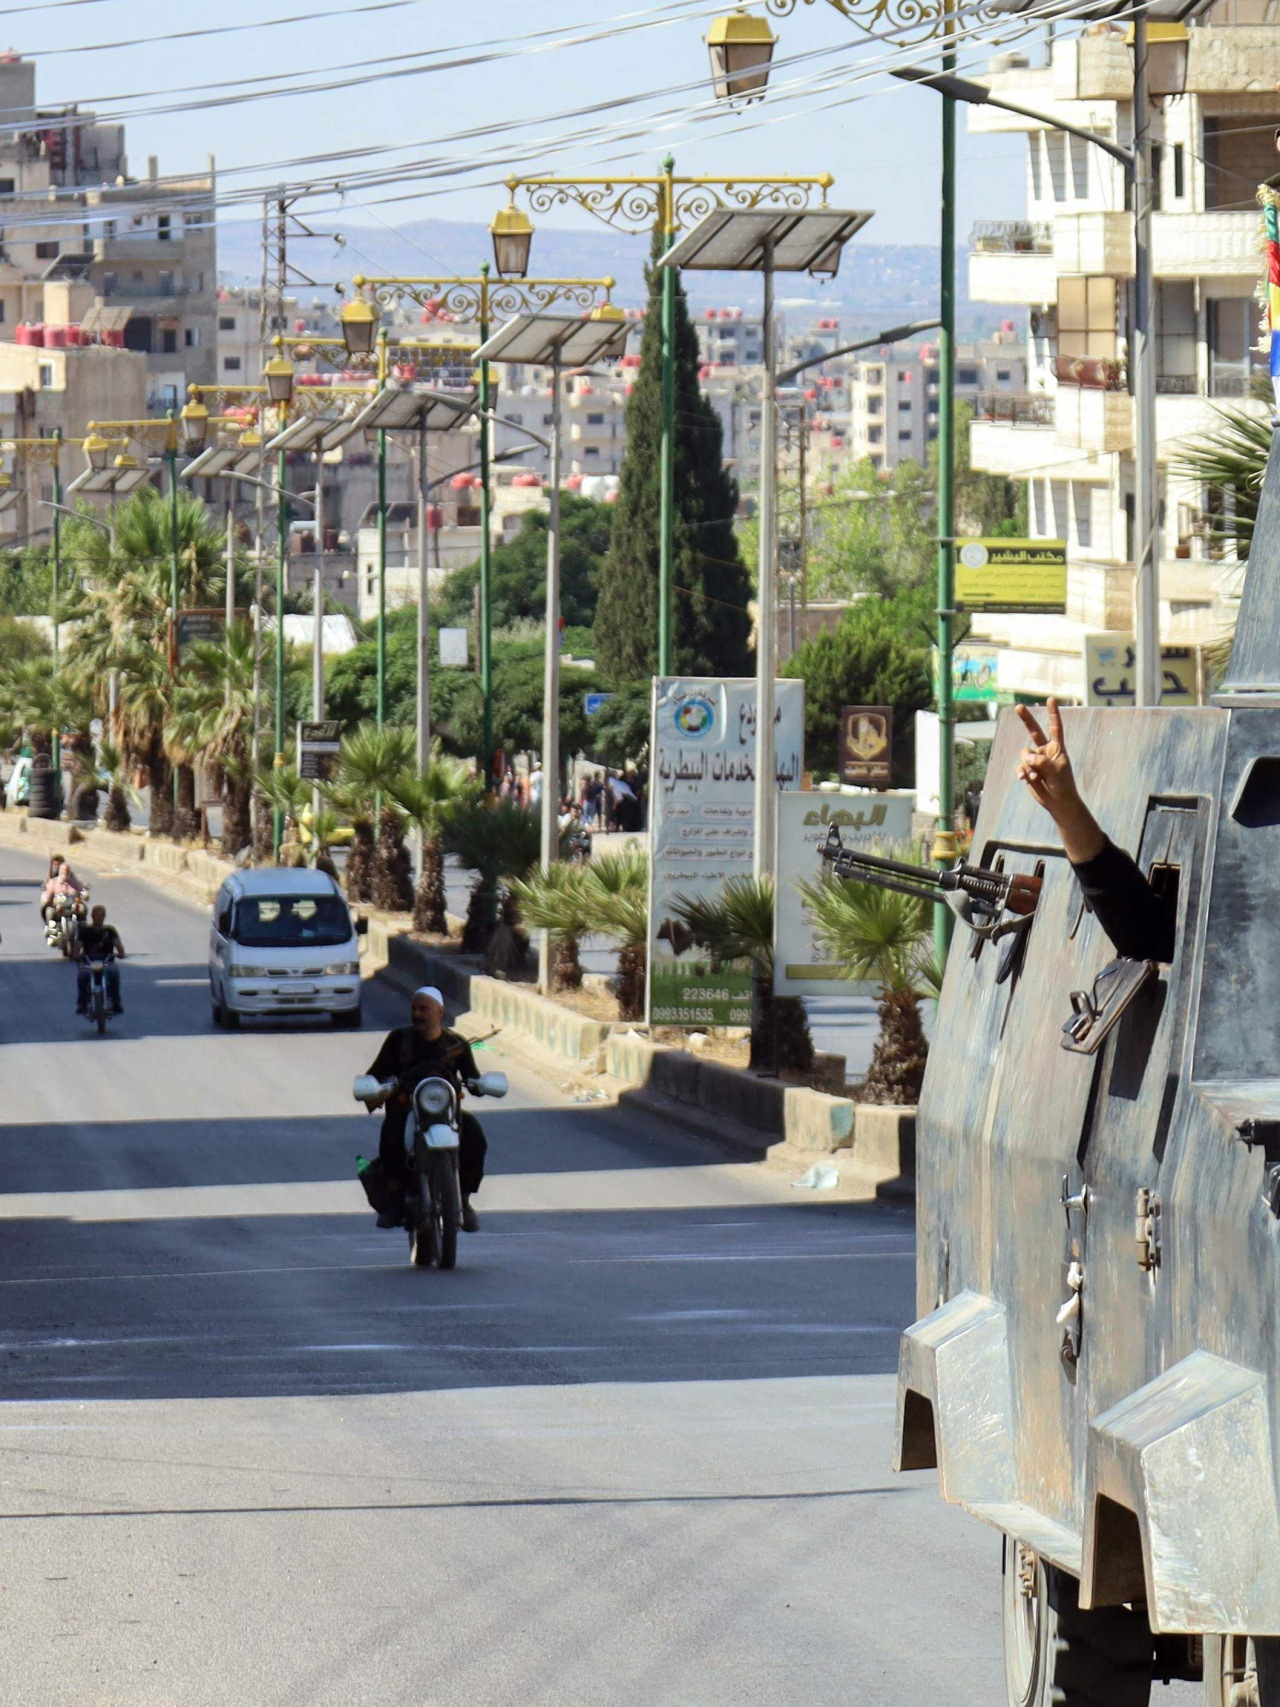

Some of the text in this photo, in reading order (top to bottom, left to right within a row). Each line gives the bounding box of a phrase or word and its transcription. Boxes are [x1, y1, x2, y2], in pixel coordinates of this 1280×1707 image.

[659, 748, 708, 792] البيطرية
[803, 803, 888, 831] البهاء
[683, 987, 730, 1001] 223646
[653, 1007, 715, 1021] 0993351535
